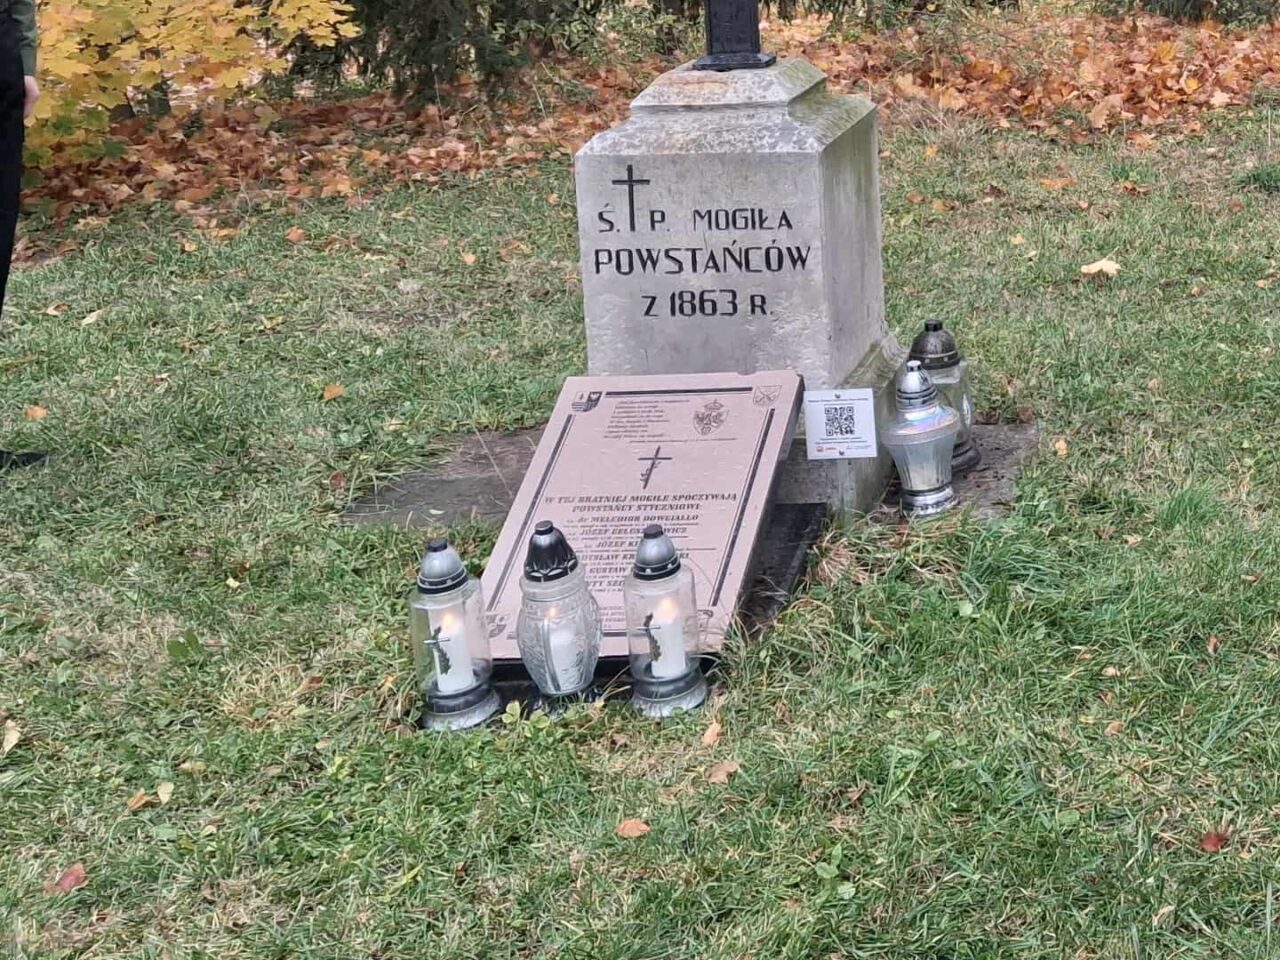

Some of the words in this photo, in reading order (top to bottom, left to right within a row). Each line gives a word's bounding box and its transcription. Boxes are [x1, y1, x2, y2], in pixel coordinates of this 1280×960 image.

[693, 208, 793, 231] MOGIŁA
[594, 239, 811, 275] POWSTAŃCÓW
[669, 289, 738, 317] 1863
[558, 496, 577, 504] TEJ
[577, 495, 628, 504] BRATNIEJ
[629, 494, 670, 503] MOGILE
[671, 493, 738, 502] SPOCZYWAJĄ
[572, 504, 634, 513] POWSTAŃCY
